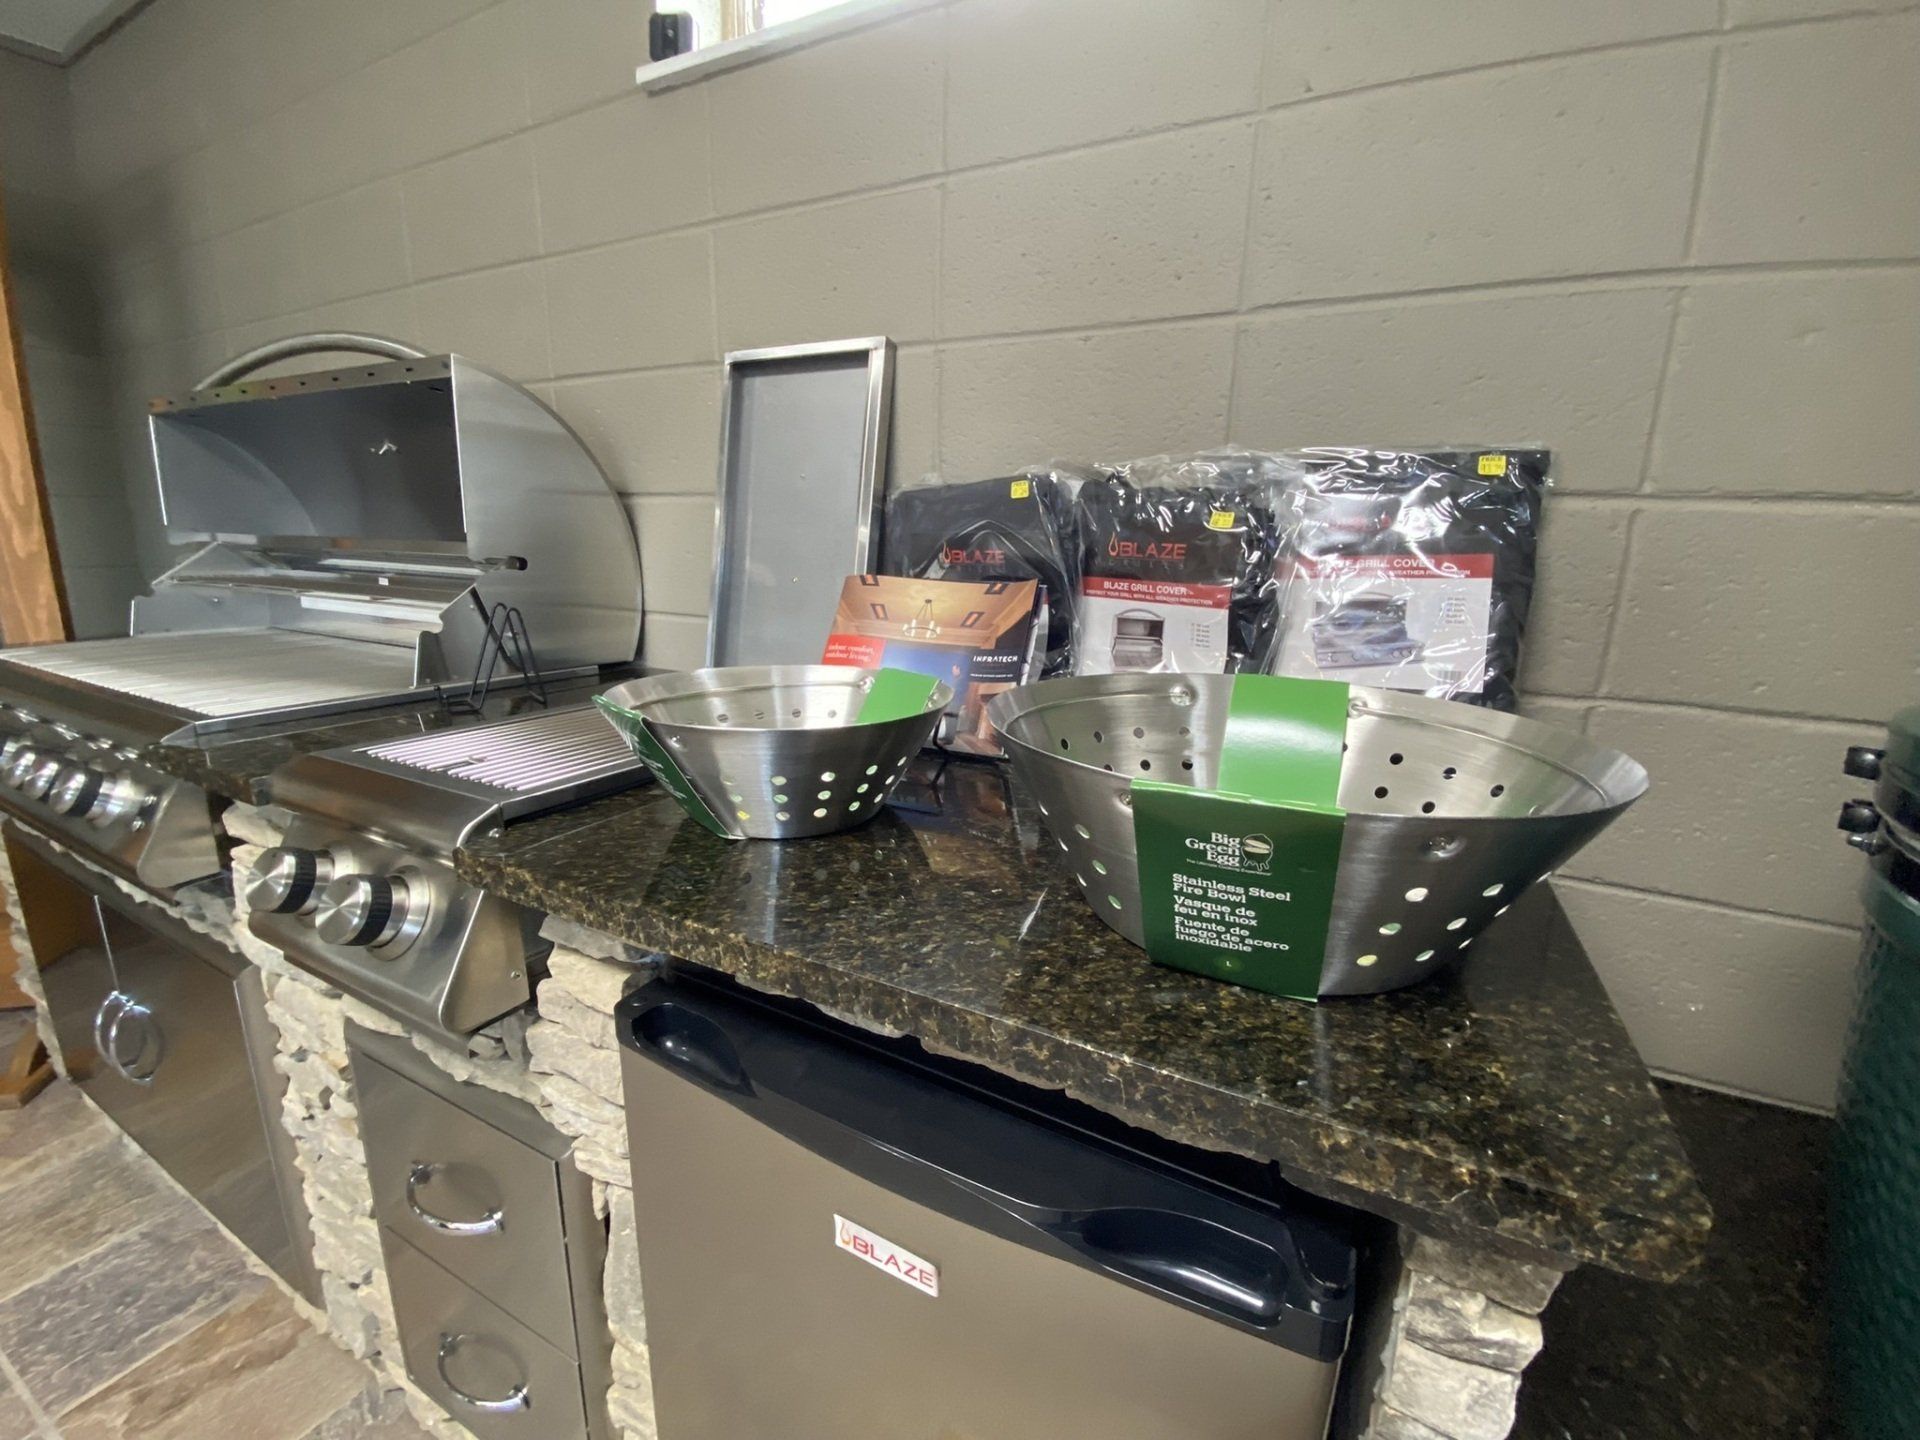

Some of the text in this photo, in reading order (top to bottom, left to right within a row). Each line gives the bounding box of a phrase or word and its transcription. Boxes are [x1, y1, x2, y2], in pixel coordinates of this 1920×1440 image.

[951, 549, 1005, 564] BLAZE
[1120, 541, 1187, 559] BLAZE
[1103, 581, 1188, 596] BLAZE GRILL COVER
[973, 655, 1018, 663] INFRATECH
[1185, 838, 1240, 856] Green
[1211, 832, 1240, 848] Big
[1207, 850, 1240, 867] Egg
[1172, 873, 1291, 902] Stainless Steel
[1173, 882, 1246, 904] Fire Bowl
[1173, 895, 1256, 918] Vasque de
[1174, 903, 1258, 927] feu en inox
[1174, 916, 1250, 937] Fuente de
[1175, 923, 1290, 951] fuego de acero
[1175, 931, 1253, 953] inoxidable
[1226, 960, 1232, 968] L
[853, 1235, 934, 1289] BLAZE
